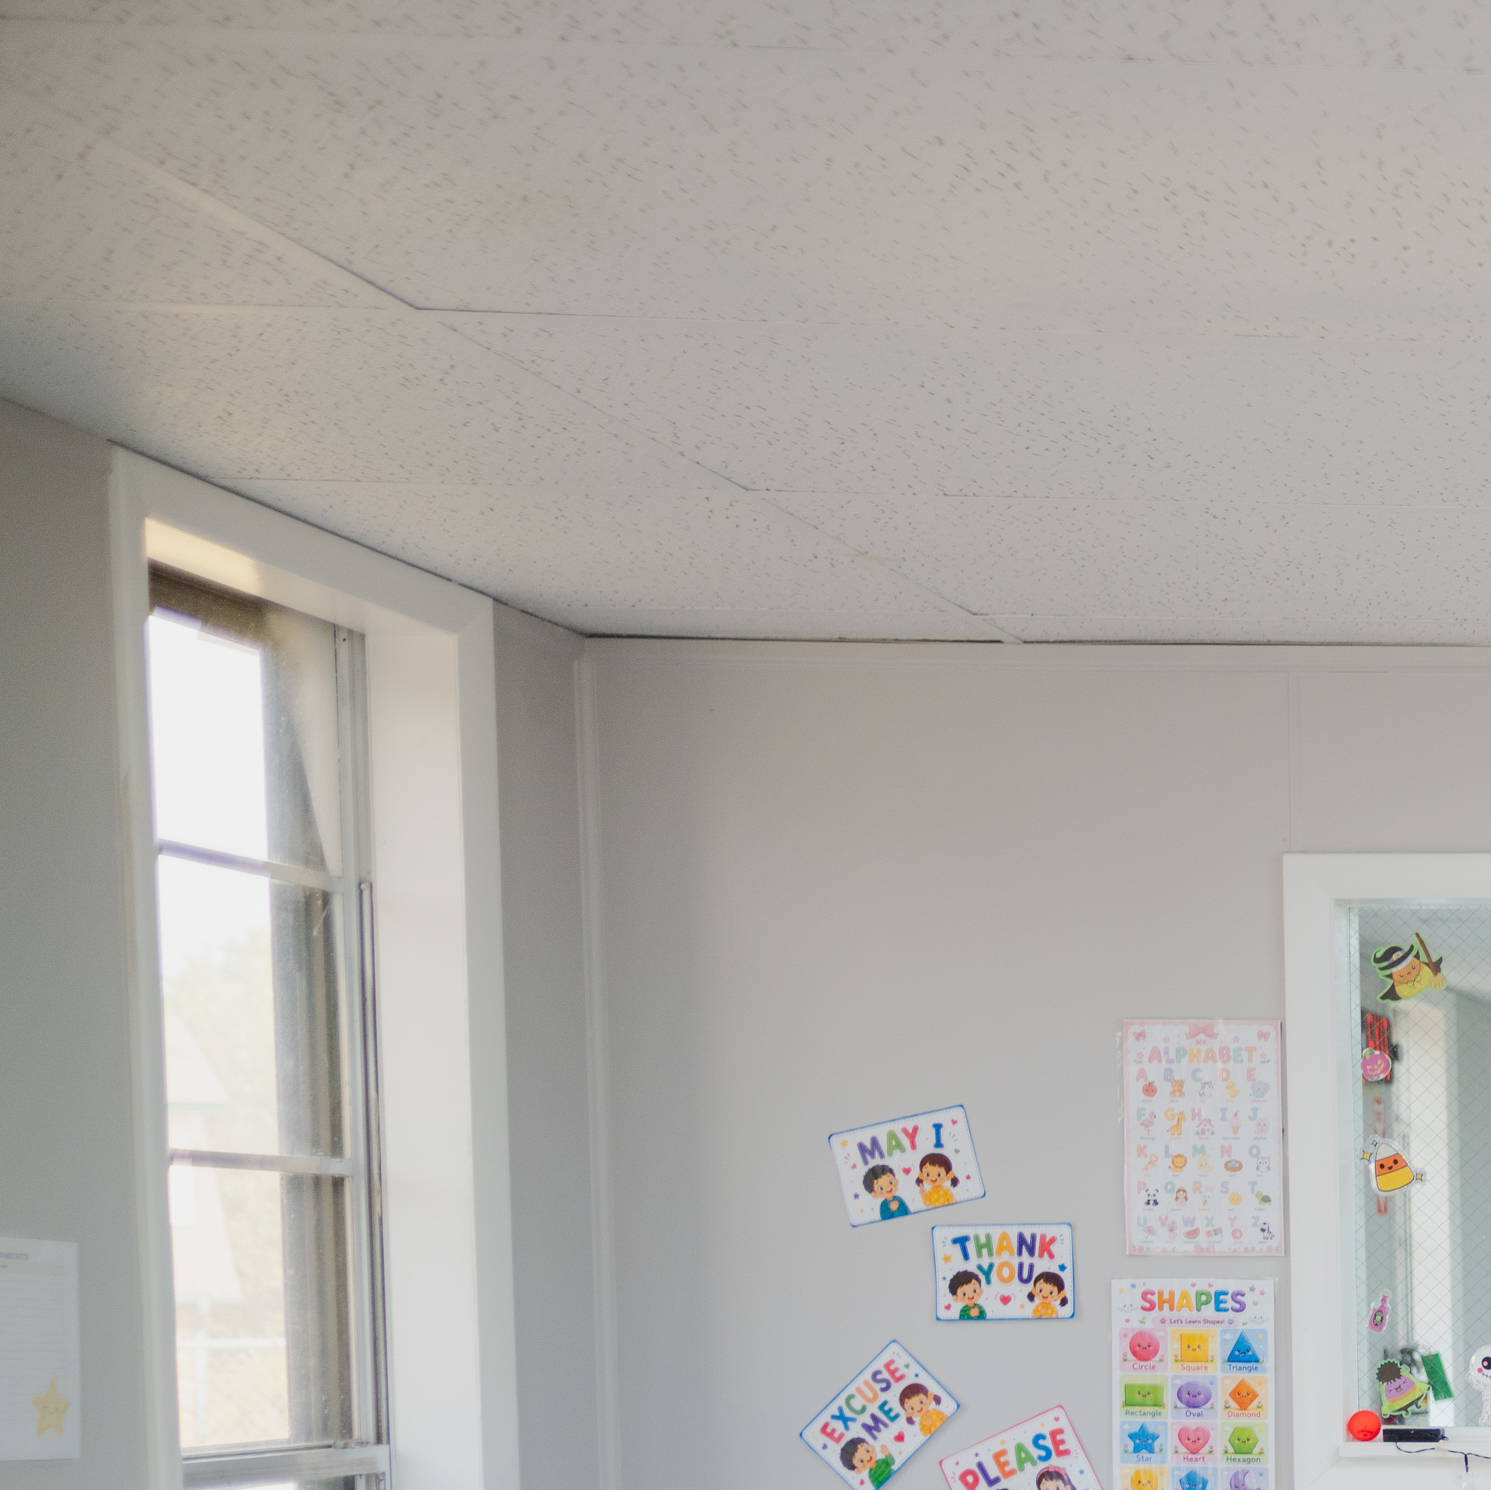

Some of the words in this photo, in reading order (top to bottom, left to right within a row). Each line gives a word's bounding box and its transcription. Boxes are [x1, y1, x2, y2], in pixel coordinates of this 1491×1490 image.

[1148, 1046, 1257, 1064] ALPHABET
[857, 1124, 920, 1167] MAY
[932, 1122, 944, 1149] I
[952, 1230, 1058, 1263] THANK
[976, 1261, 1035, 1285] YOU
[1140, 1289, 1246, 1312] SHAPES
[1132, 1363, 1156, 1371] Circle
[1228, 1364, 1258, 1372] Triangle
[819, 1358, 907, 1445] EXCUSE
[861, 1405, 900, 1443] ME
[1125, 1410, 1162, 1418] Rectangle
[1227, 1456, 1261, 1464] Hexagon
